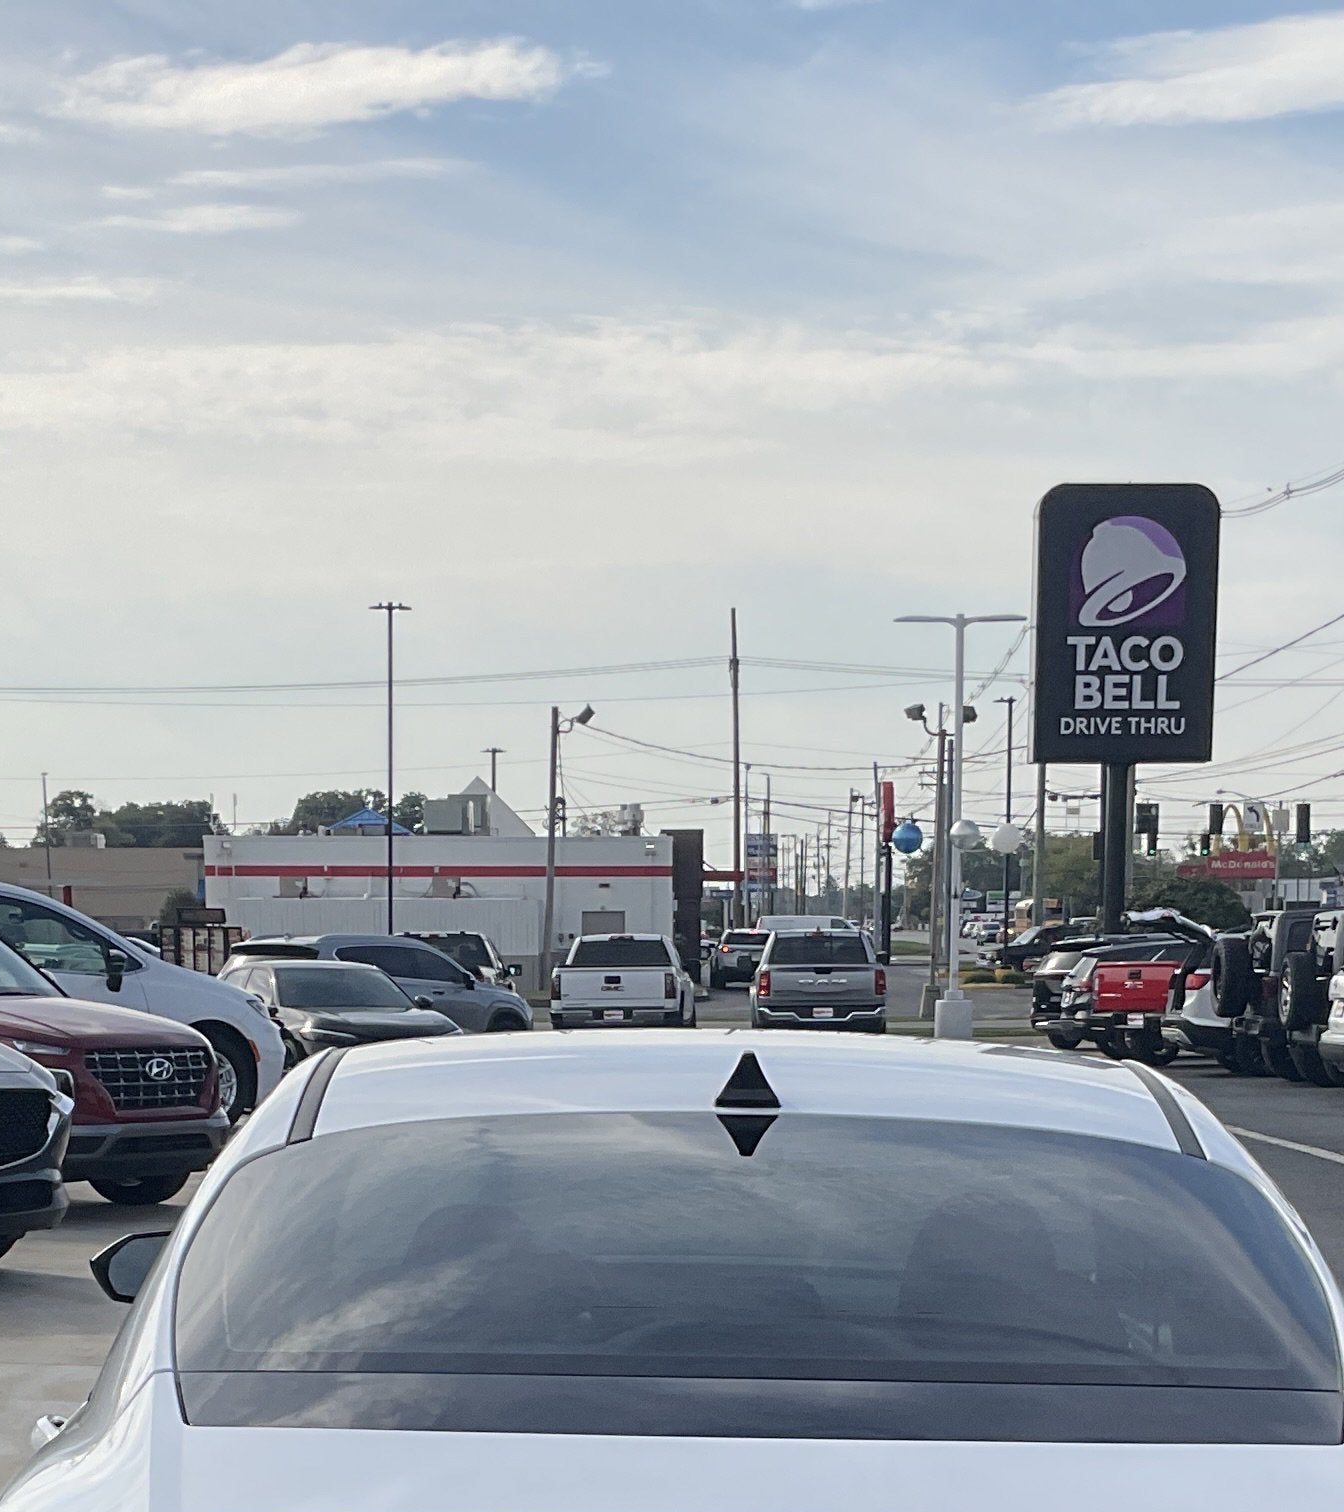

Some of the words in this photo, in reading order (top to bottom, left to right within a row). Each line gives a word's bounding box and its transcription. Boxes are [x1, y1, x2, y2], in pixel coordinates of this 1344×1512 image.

[1066, 635, 1184, 672] TACO
[1074, 674, 1181, 710] BELL
[1060, 717, 1122, 735] DRIVE
[1127, 717, 1186, 735] THRU
[1210, 860, 1275, 869] McDonald's
